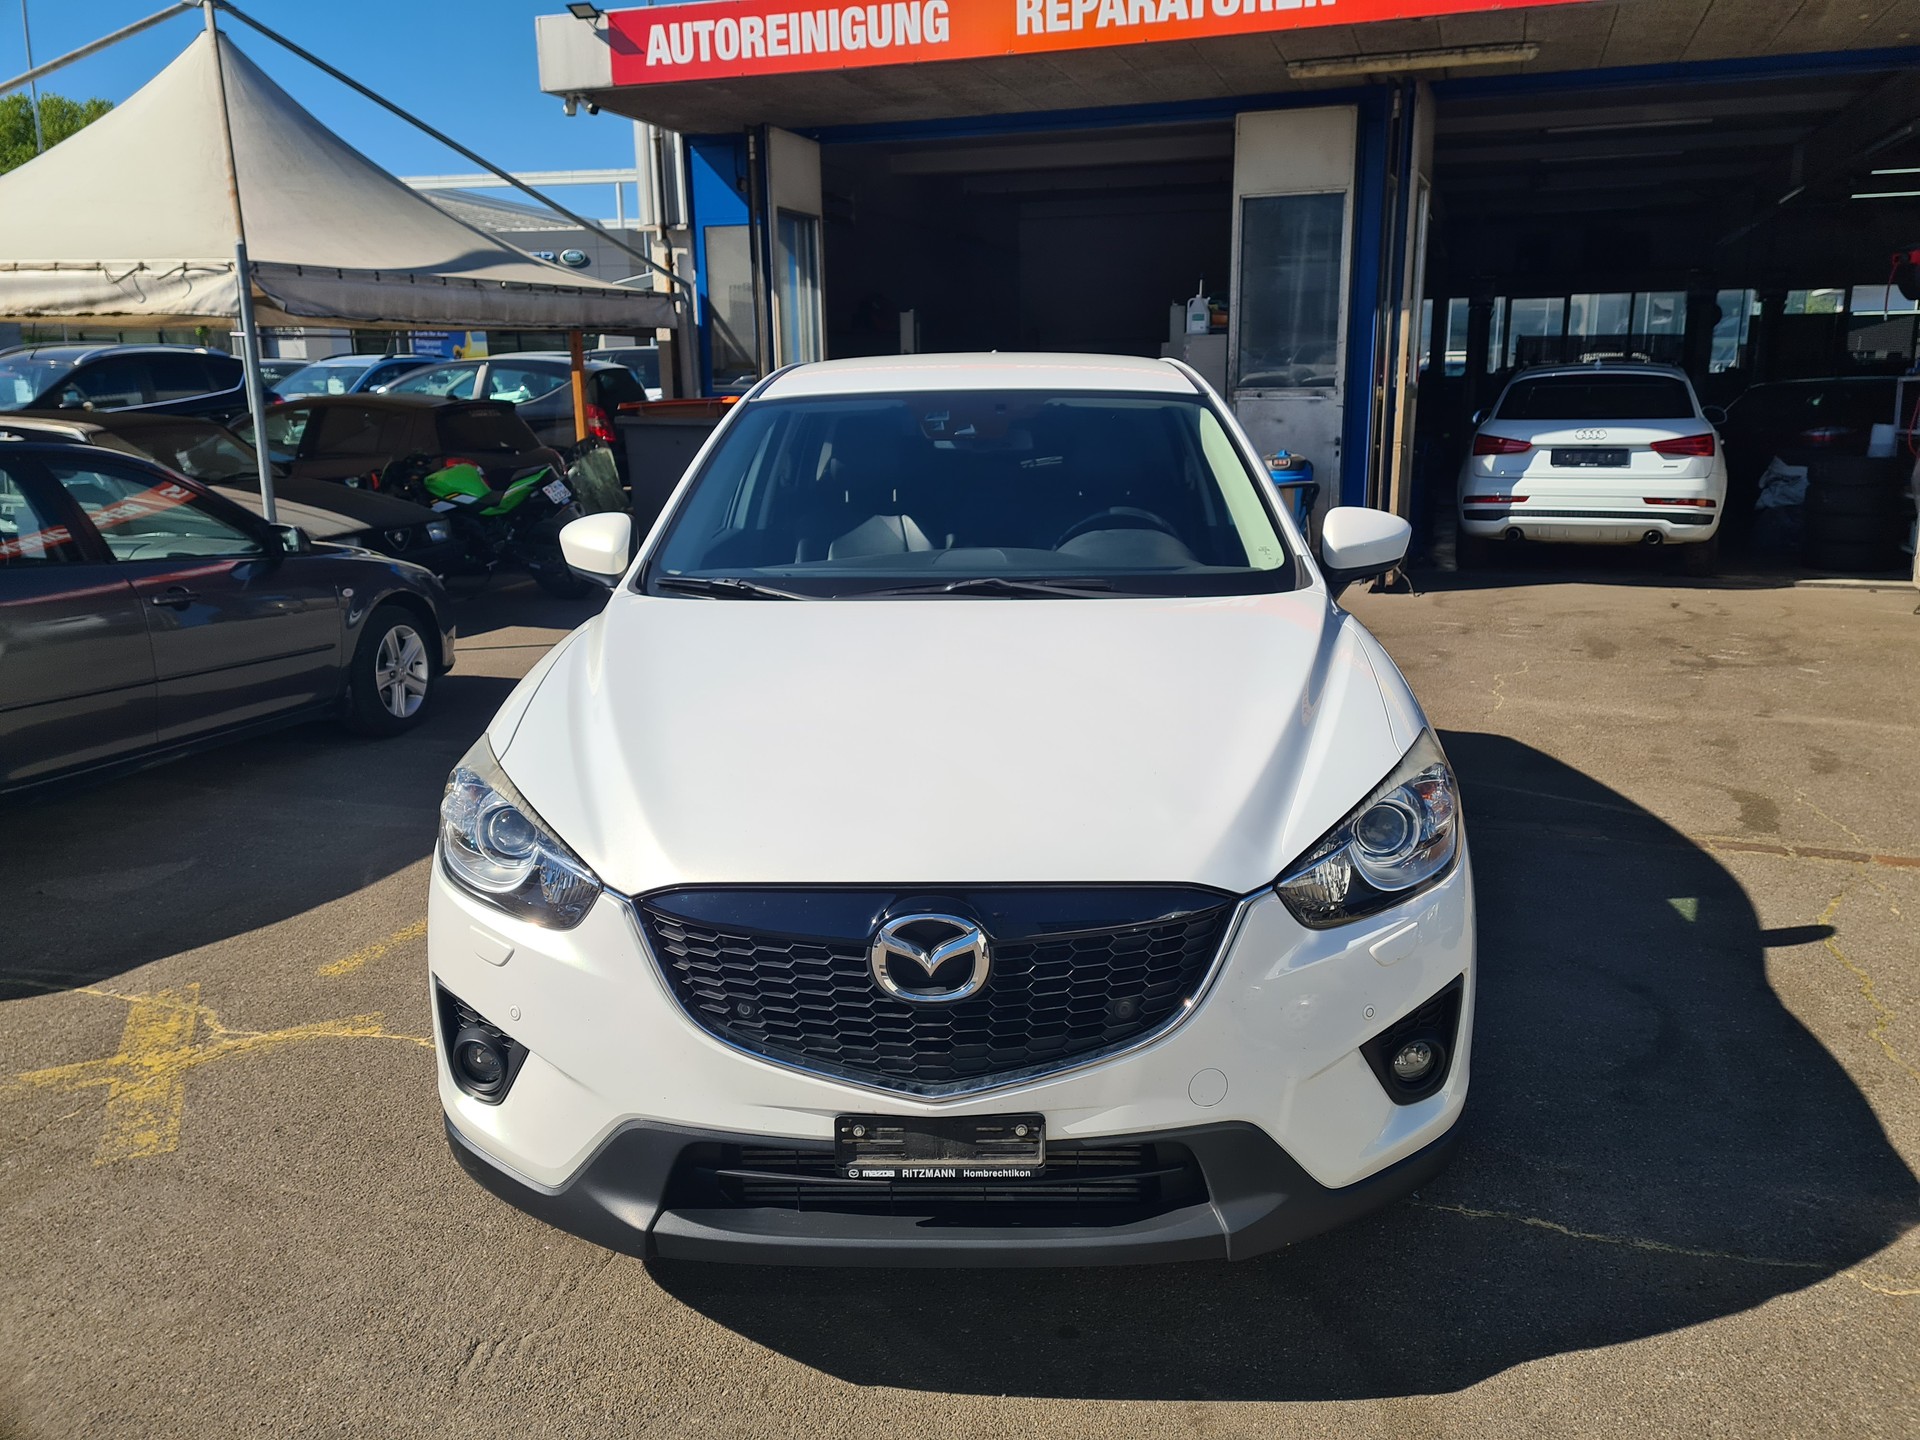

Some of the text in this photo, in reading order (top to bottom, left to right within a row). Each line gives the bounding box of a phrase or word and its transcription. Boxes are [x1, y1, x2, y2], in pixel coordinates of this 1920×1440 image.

[647, 0, 949, 67] AUTOREINIGUNG
[1016, 0, 1336, 36] REPARA
[862, 1168, 1031, 1178] mazda RITZMANN Hombrechtikon
